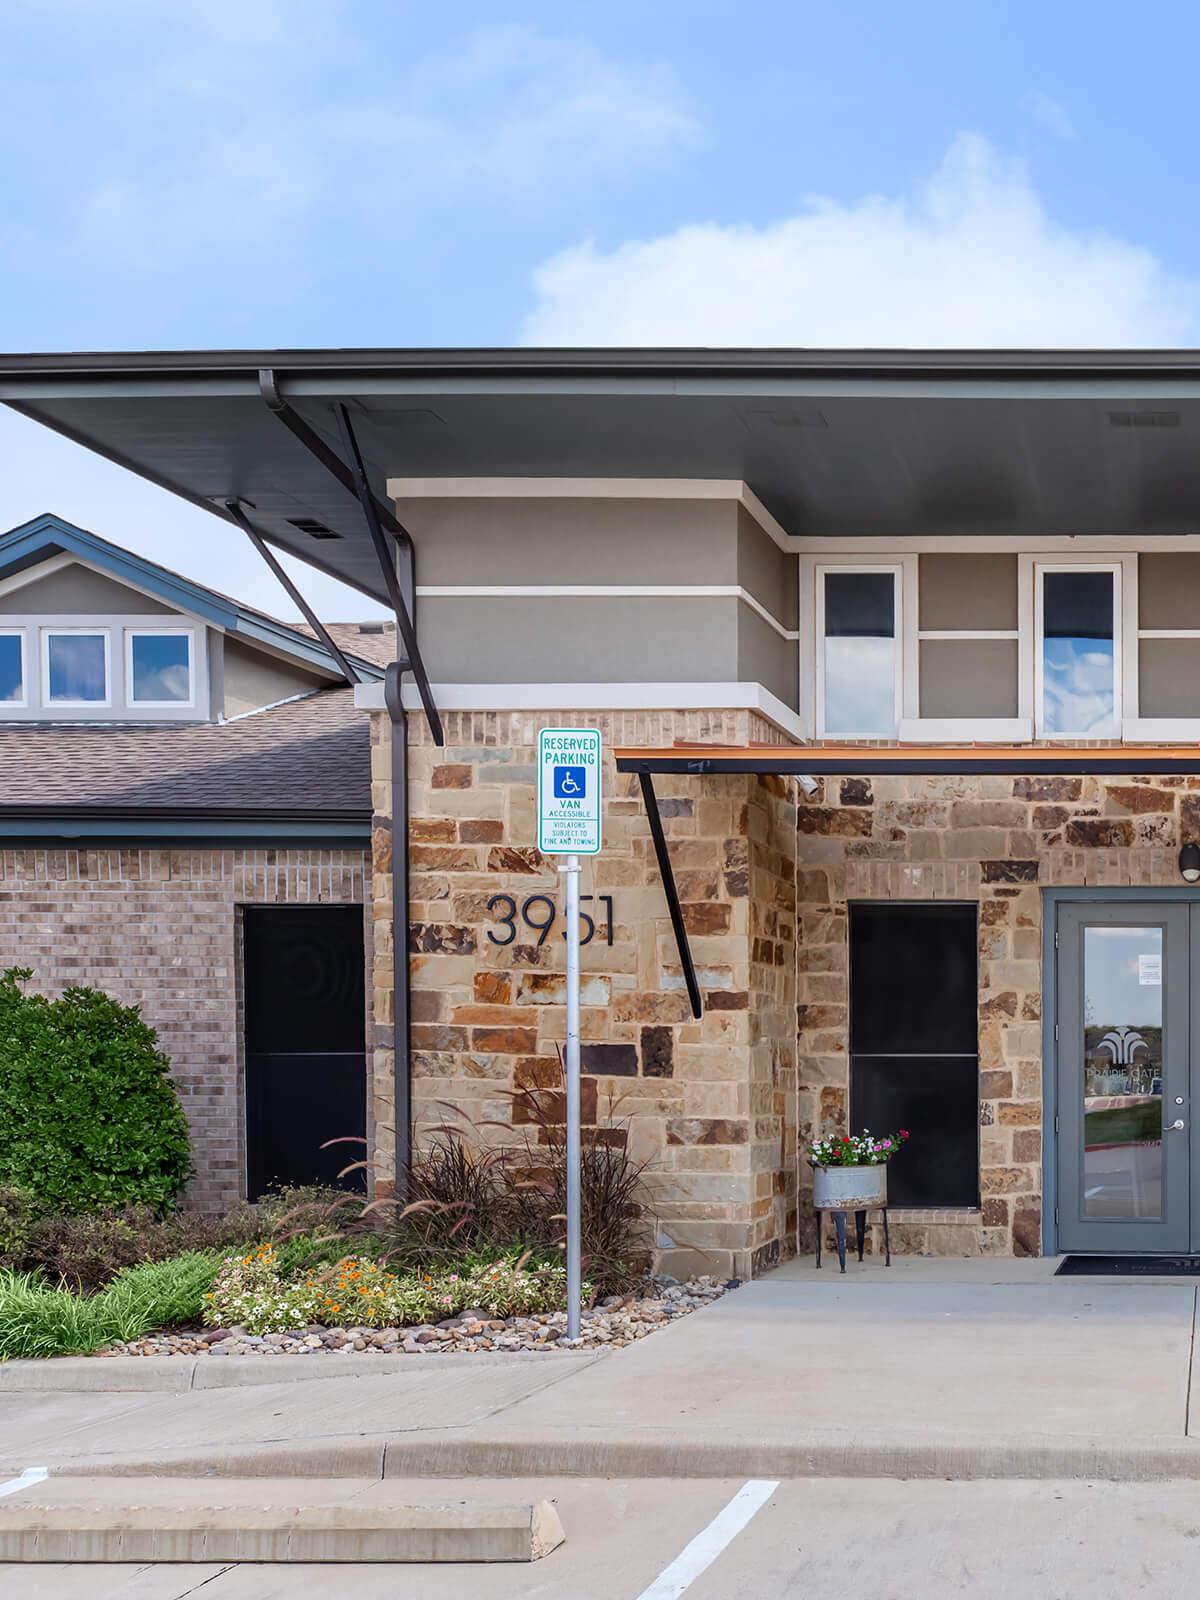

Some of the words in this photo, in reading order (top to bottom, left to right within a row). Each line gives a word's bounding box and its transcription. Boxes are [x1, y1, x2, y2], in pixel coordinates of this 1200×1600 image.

[544, 738, 596, 750] RESERVED
[545, 752, 595, 765] PARKING
[560, 800, 580, 809] VAN
[560, 838, 572, 846] AND
[574, 838, 596, 846] TOWING
[487, 895, 613, 946] 3951
[1087, 1069, 1128, 1079] PRAIRIE
[1131, 1069, 1161, 1079] GATE
